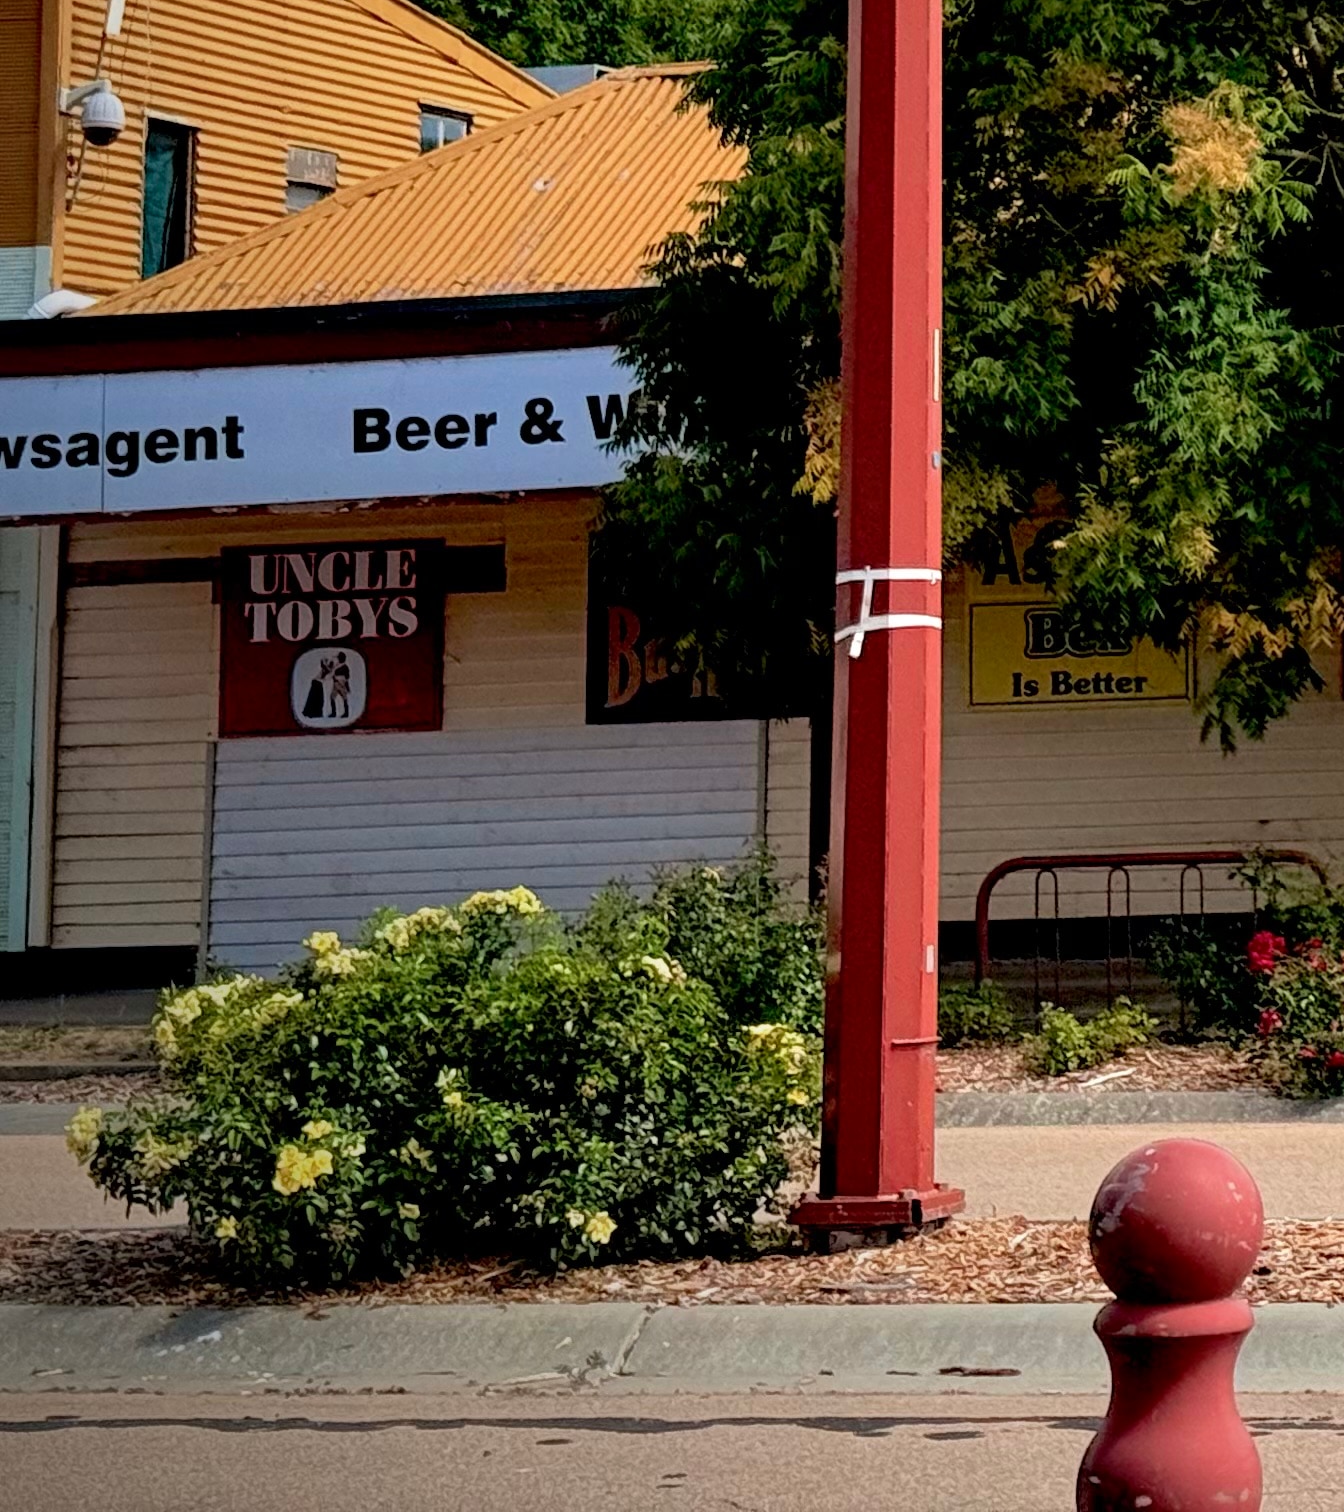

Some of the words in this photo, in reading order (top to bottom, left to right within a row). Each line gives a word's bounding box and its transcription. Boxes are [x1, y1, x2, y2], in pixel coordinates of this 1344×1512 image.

[353, 407, 498, 454] Beer
[519, 396, 565, 446] &
[249, 548, 417, 595] UNCLE
[244, 595, 419, 643] TOBYS
[1012, 672, 1039, 697] Is
[1051, 670, 1148, 696] Better
